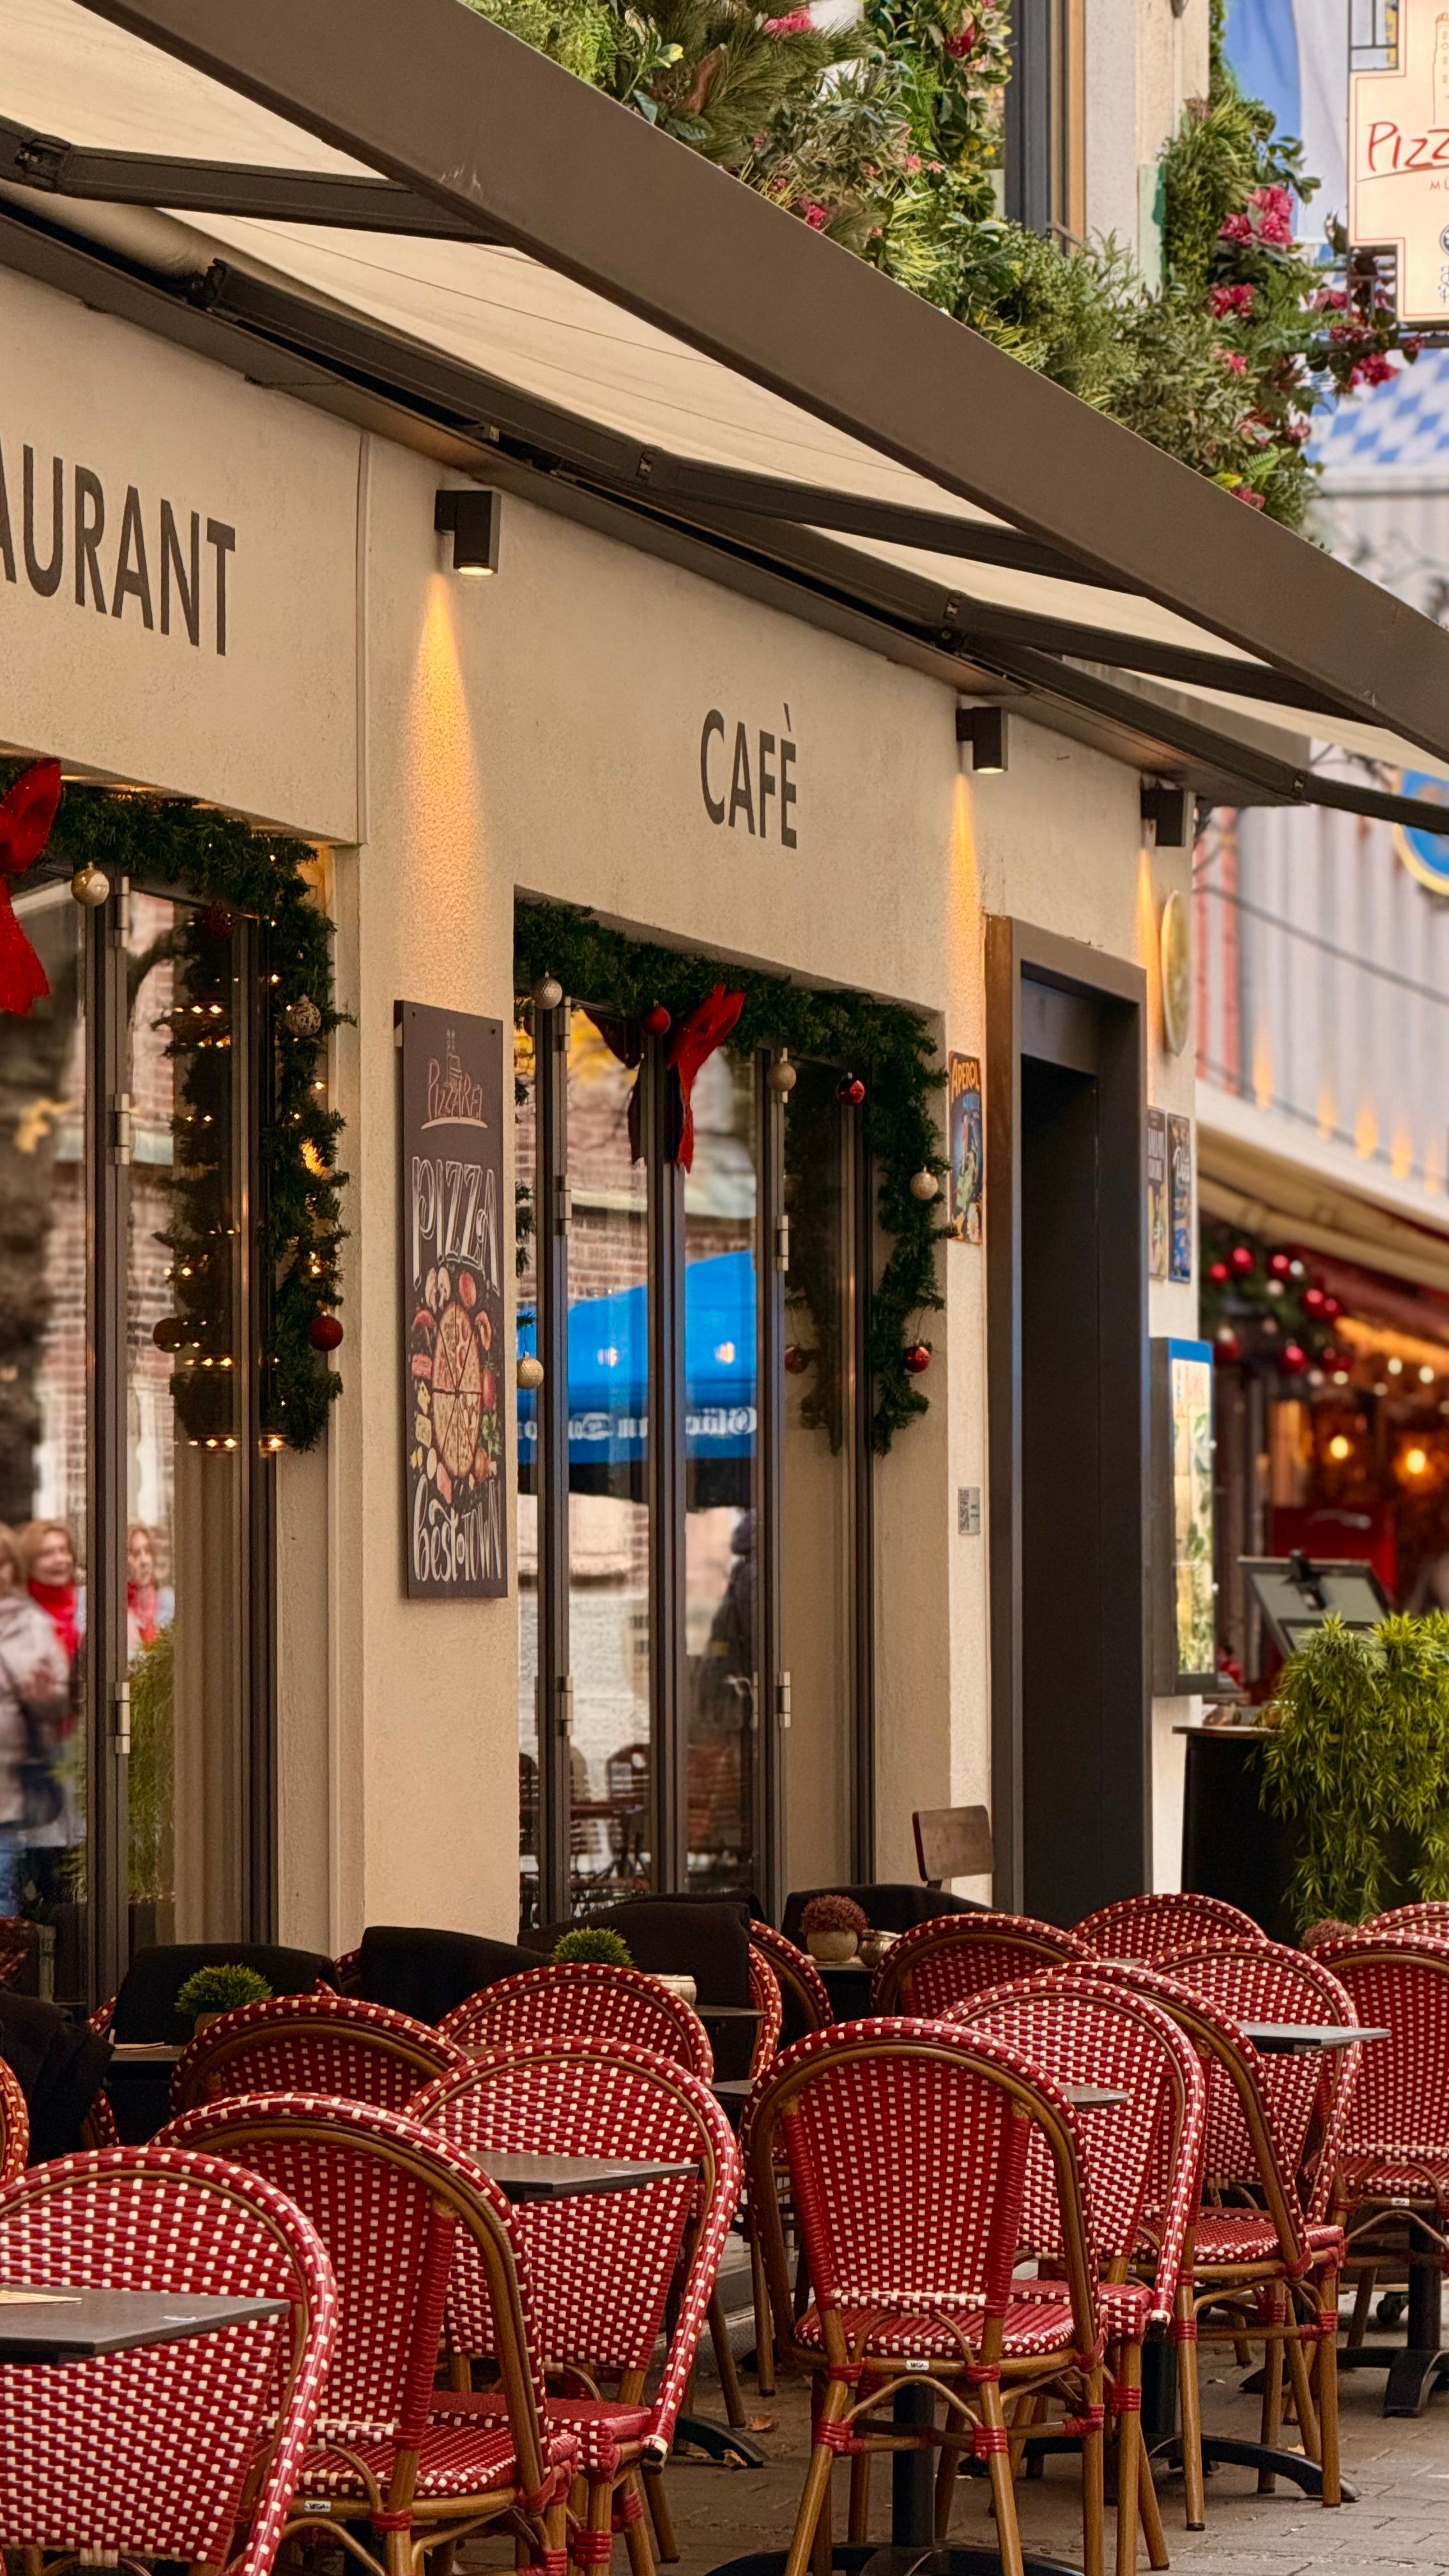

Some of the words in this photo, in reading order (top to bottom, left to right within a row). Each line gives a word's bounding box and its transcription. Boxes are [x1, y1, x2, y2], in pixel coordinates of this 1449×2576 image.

[700, 702, 797, 850] CAFÈ
[951, 1058, 980, 1103] APEROL
[412, 1156, 500, 1297] PIZZA
[461, 1479, 502, 1581] TOWN
